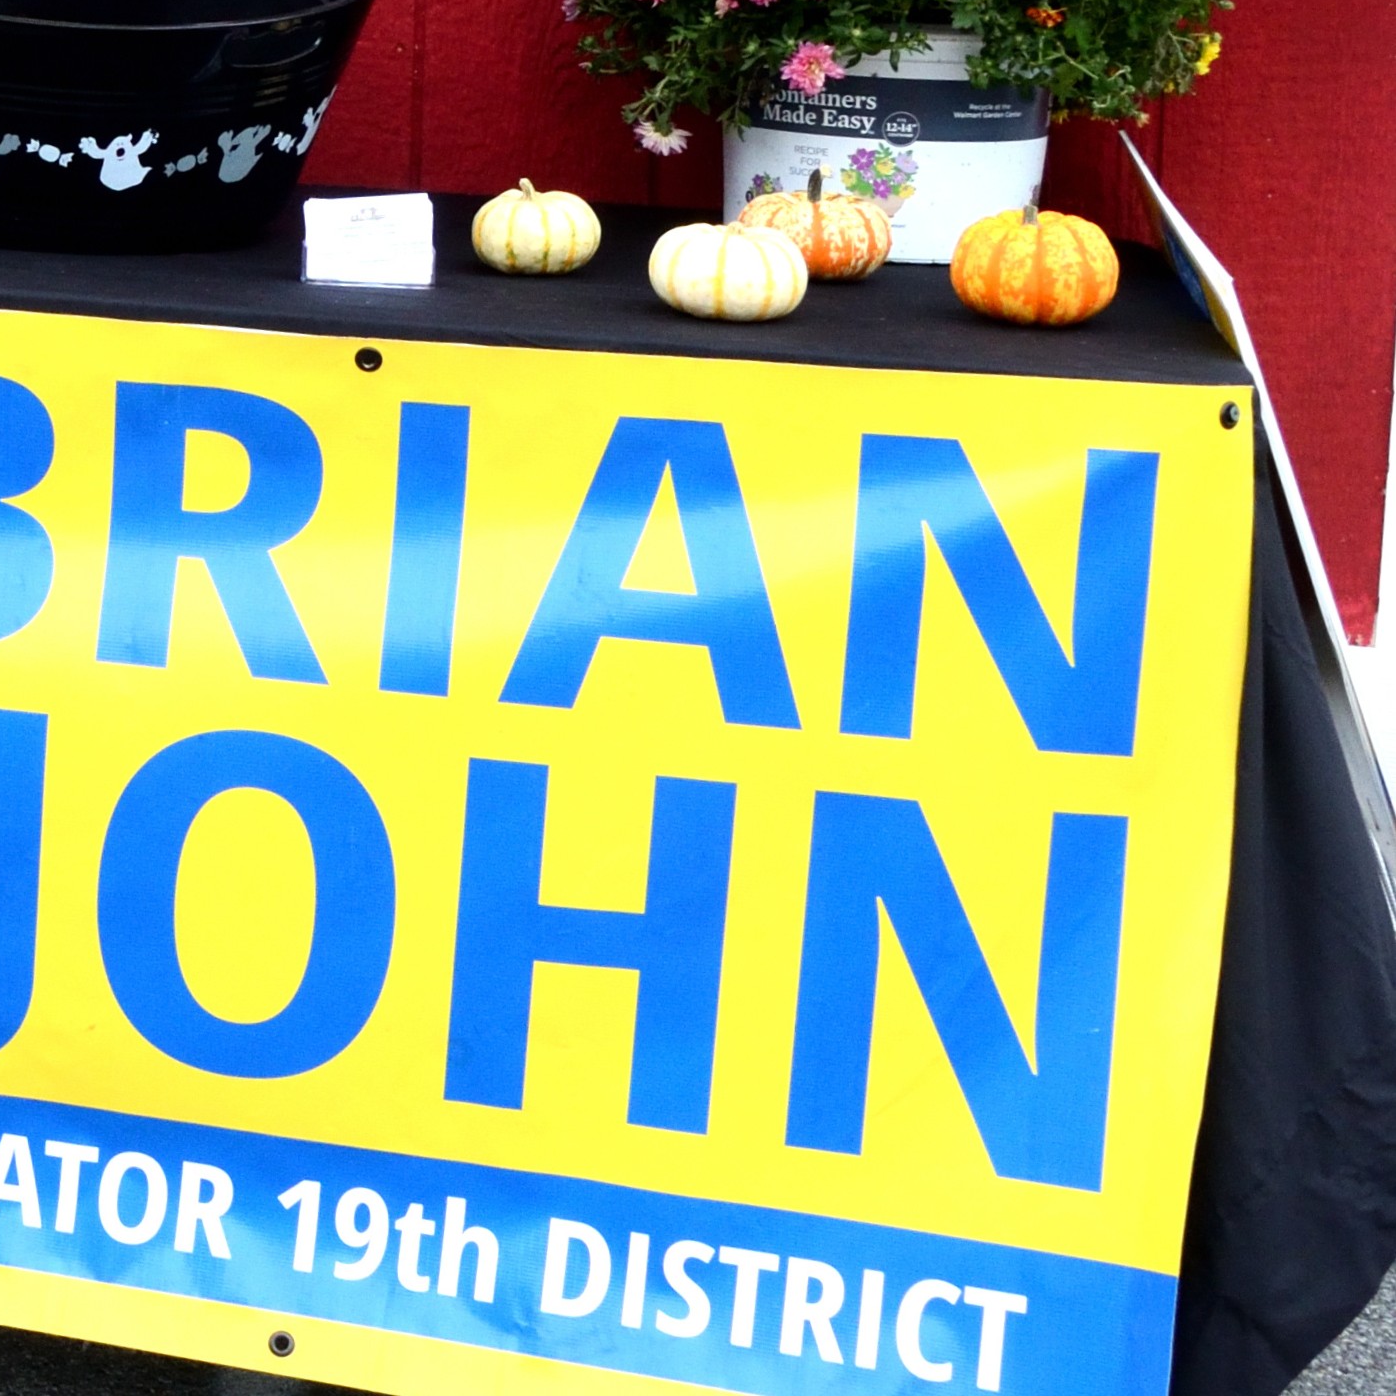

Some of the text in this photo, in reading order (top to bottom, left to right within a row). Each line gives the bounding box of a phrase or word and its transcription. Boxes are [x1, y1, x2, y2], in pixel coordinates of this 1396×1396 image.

[763, 104, 876, 134] Made Easy
[953, 111, 981, 119] Walmart
[794, 145, 829, 156] RECIPE
[800, 157, 821, 166] FOR
[277, 1179, 500, 1304] 19th
[538, 1217, 1028, 1393] DISTRICT
